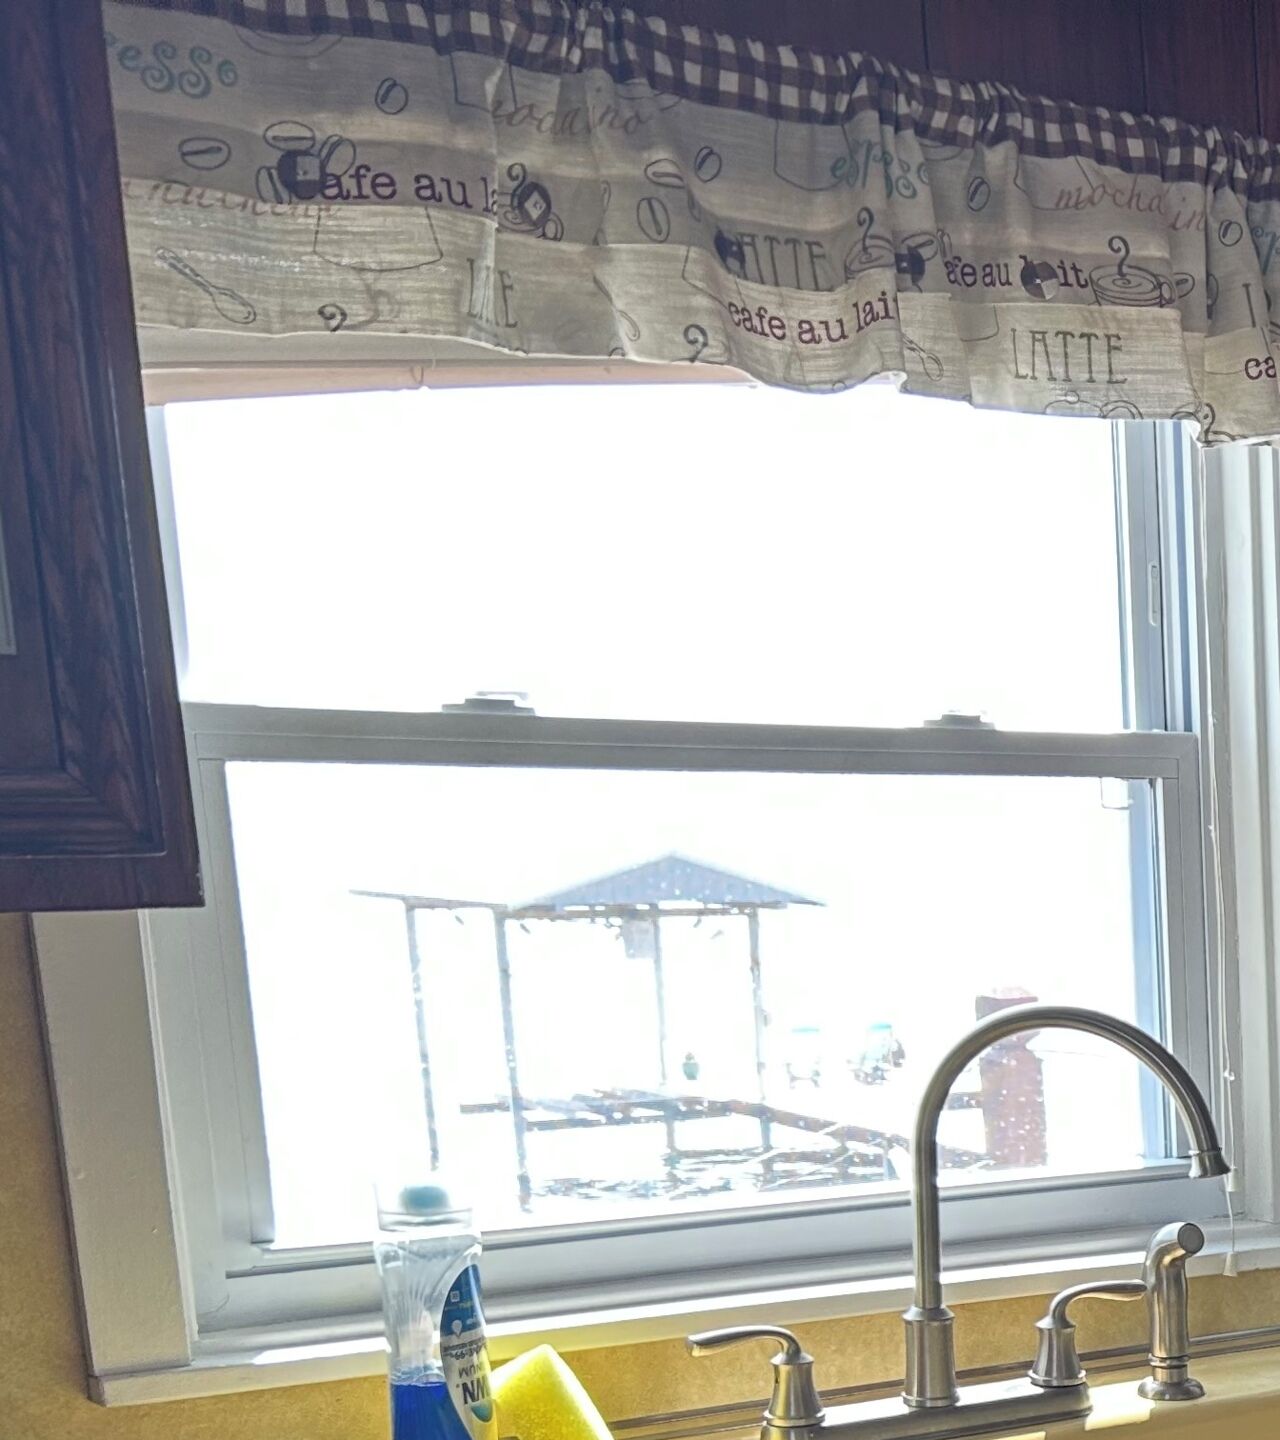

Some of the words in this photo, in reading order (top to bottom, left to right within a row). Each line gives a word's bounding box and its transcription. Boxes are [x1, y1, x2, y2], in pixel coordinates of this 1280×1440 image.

[315, 163, 397, 201] afe
[414, 173, 473, 209] au
[982, 261, 1013, 288] au
[727, 302, 787, 341] cafe
[798, 318, 849, 345] au
[1010, 327, 1128, 385] LATTE
